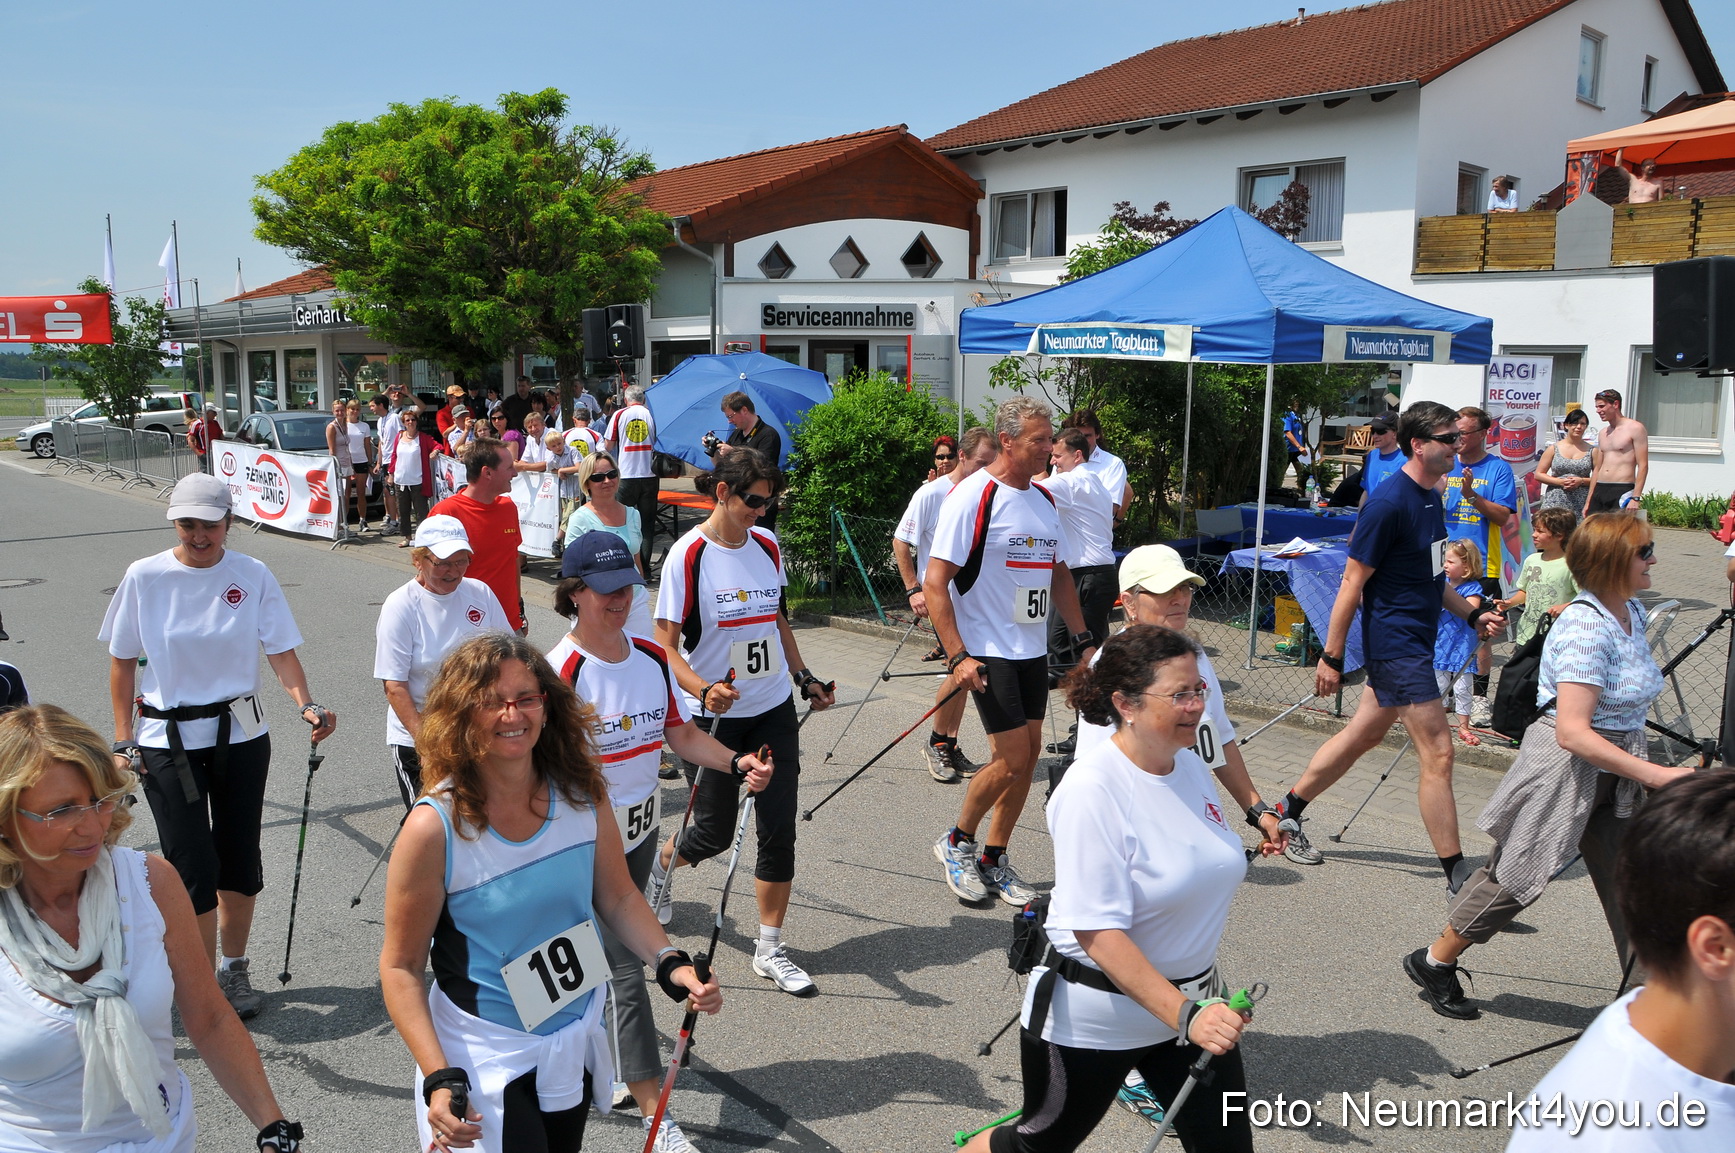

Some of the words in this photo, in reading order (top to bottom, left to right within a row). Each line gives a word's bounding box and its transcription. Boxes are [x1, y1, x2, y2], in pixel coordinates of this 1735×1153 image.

[295, 305, 341, 326] Gerhart
[763, 305, 914, 327] Serviceannahme
[1044, 332, 1108, 350] Neumarkter
[1109, 332, 1160, 352] Tagblatt
[1351, 336, 1398, 356] Neumarkter
[1399, 338, 1430, 358] Tagblatt
[1505, 401, 1541, 410] Yourself
[223, 457, 235, 471] KIA
[306, 518, 334, 529] SEAT
[1027, 588, 1047, 619] 50
[747, 639, 770, 675] 51
[627, 795, 655, 841] 59
[527, 936, 585, 1004] 19
[280, 1121, 290, 1153] LEKI
